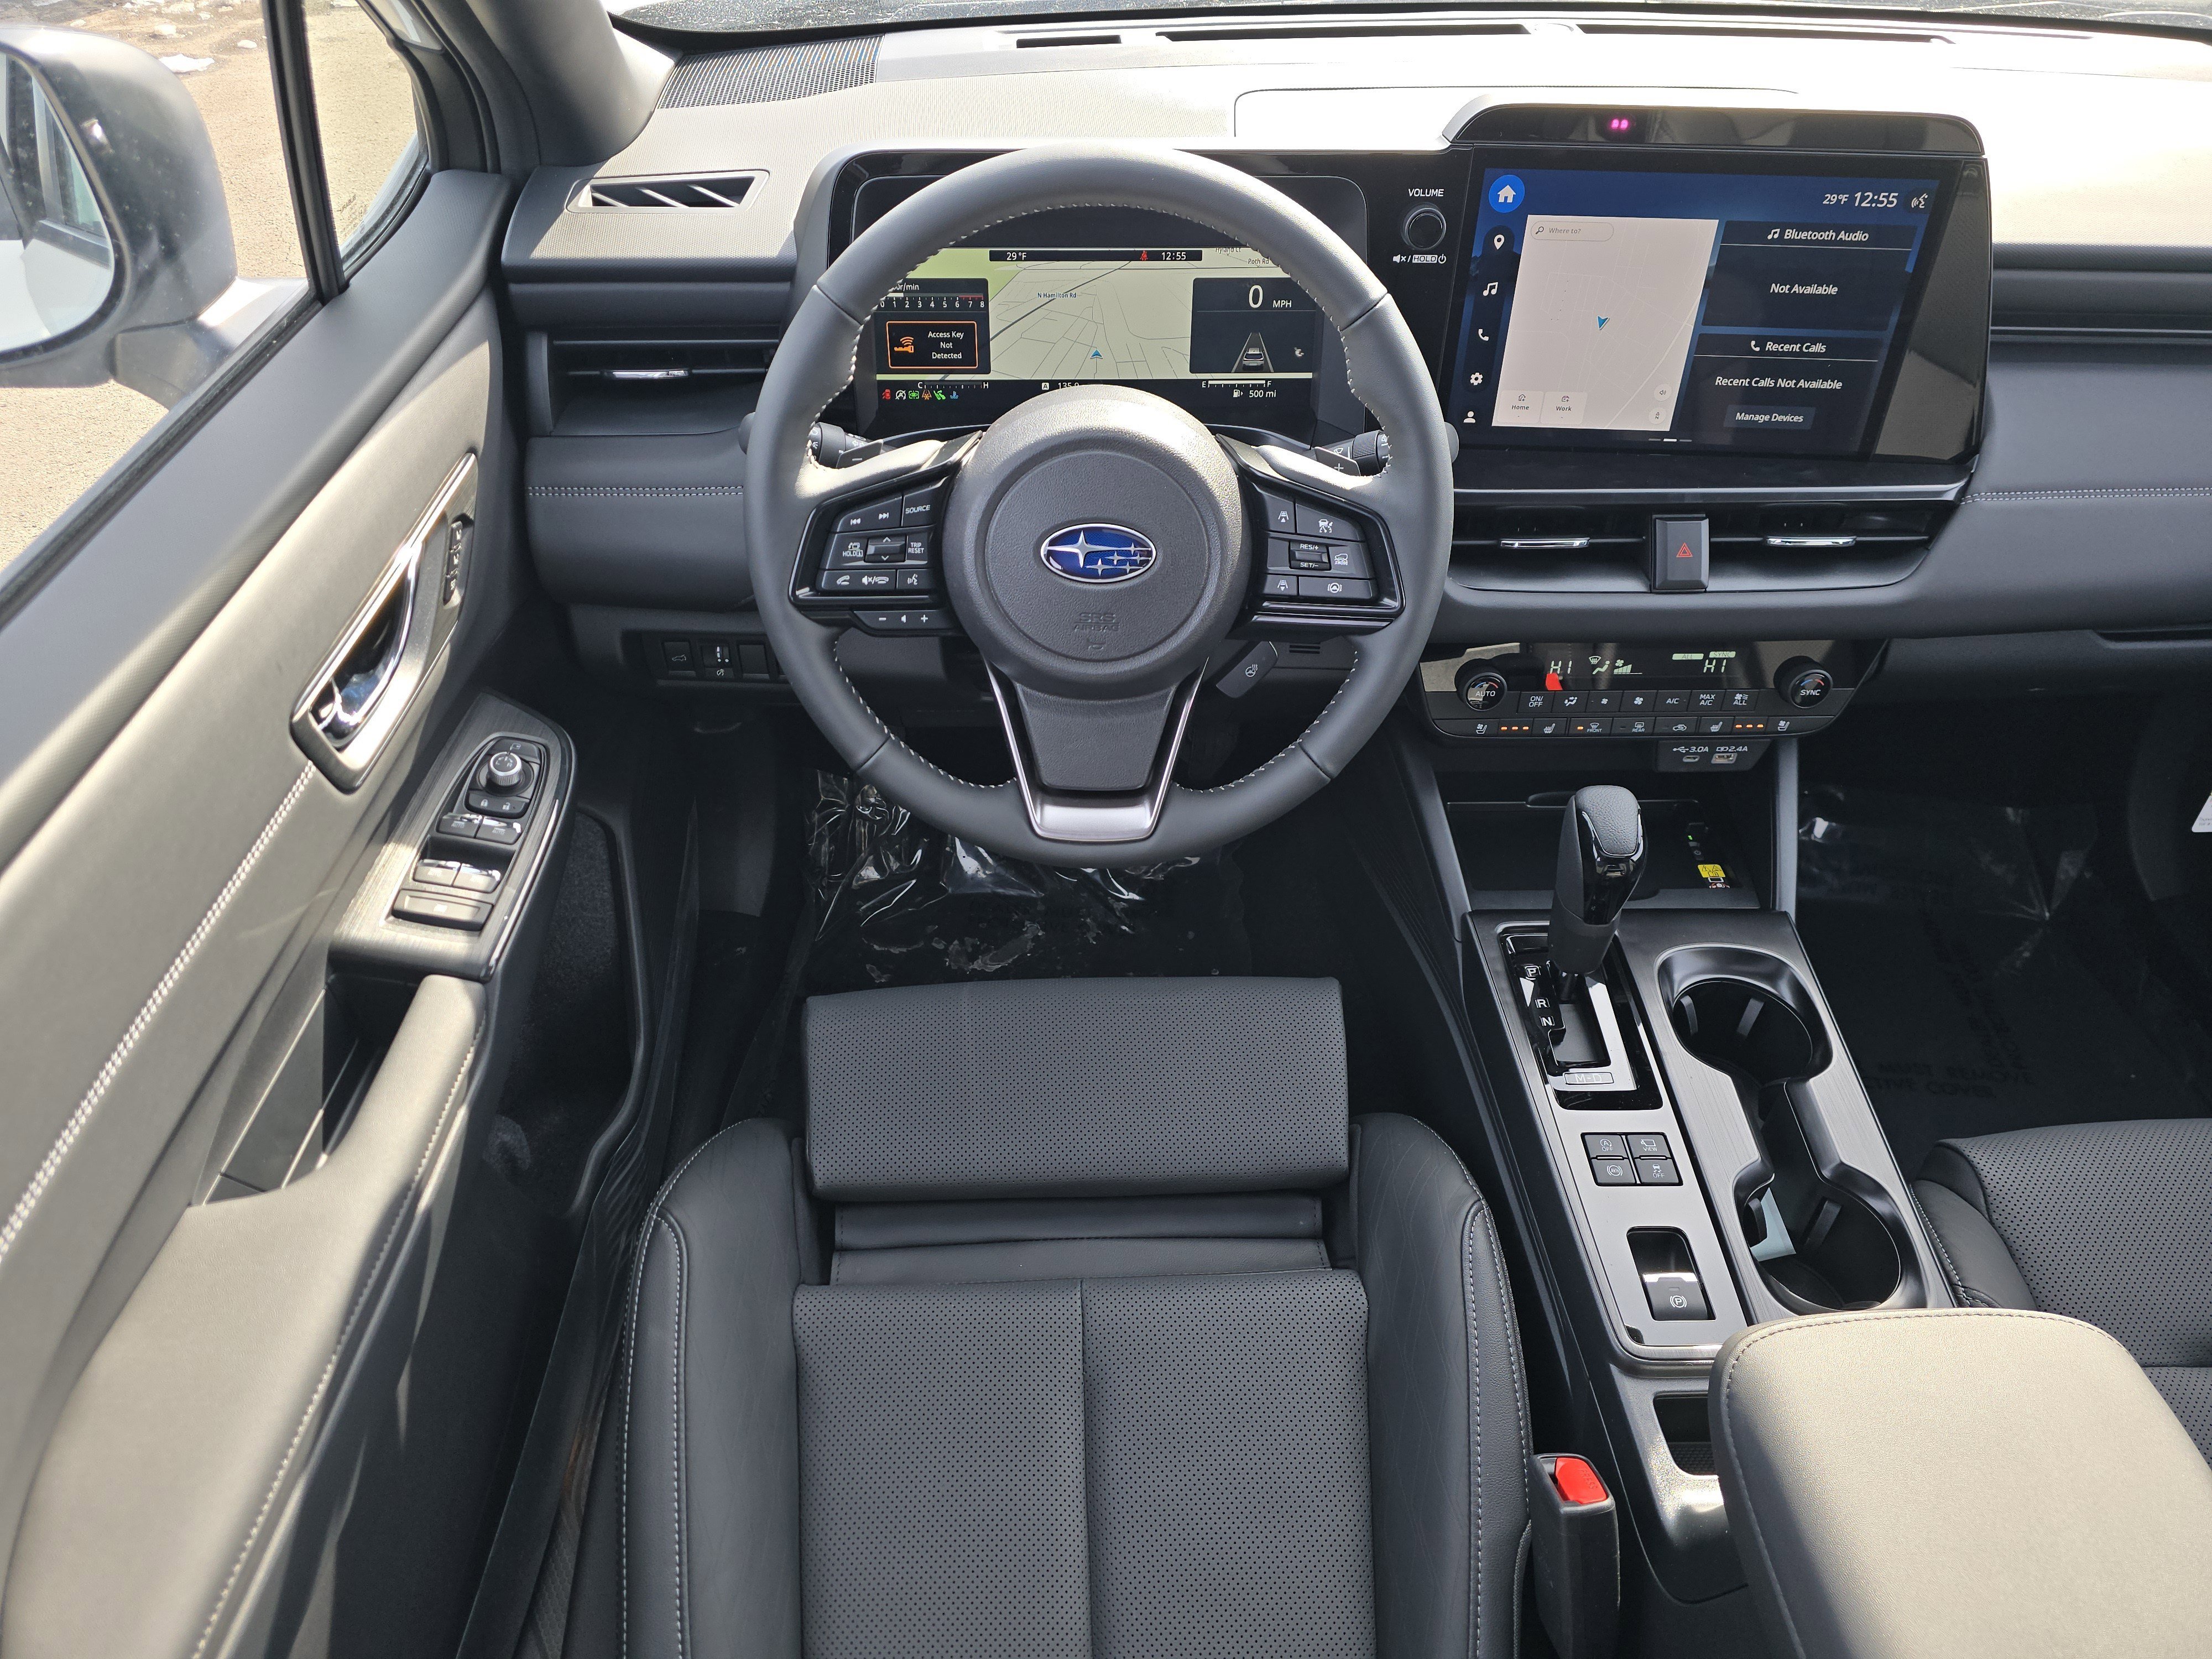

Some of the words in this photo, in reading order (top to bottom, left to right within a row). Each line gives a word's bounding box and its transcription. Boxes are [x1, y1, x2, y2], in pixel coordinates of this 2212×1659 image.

[1408, 188, 1444, 197] VOLUME
[1854, 191, 1898, 207] 12:55
[1784, 229, 1835, 240] Bluetooth
[1837, 231, 1869, 241] Audio
[1161, 252, 1186, 260] 12:55
[1770, 284, 1790, 293] Not
[1791, 285, 1838, 295] Available
[1249, 285, 1263, 308] 0
[952, 331, 964, 340] Key
[1766, 342, 1800, 352] Recent
[1802, 342, 1826, 352] Calls
[1715, 377, 1750, 386] Recent
[1751, 378, 1775, 387] Calls
[1777, 378, 1796, 388] Not
[1797, 379, 1842, 389] Available
[1736, 413, 1770, 422] Manage
[1771, 414, 1803, 422] Devices
[905, 504, 931, 514] SOURCE
[1079, 613, 1115, 622] SRS
[1550, 660, 1572, 674] HI
[1703, 659, 1726, 673] HI
[1537, 998, 1547, 1008] R
[1542, 1017, 1552, 1026] N
